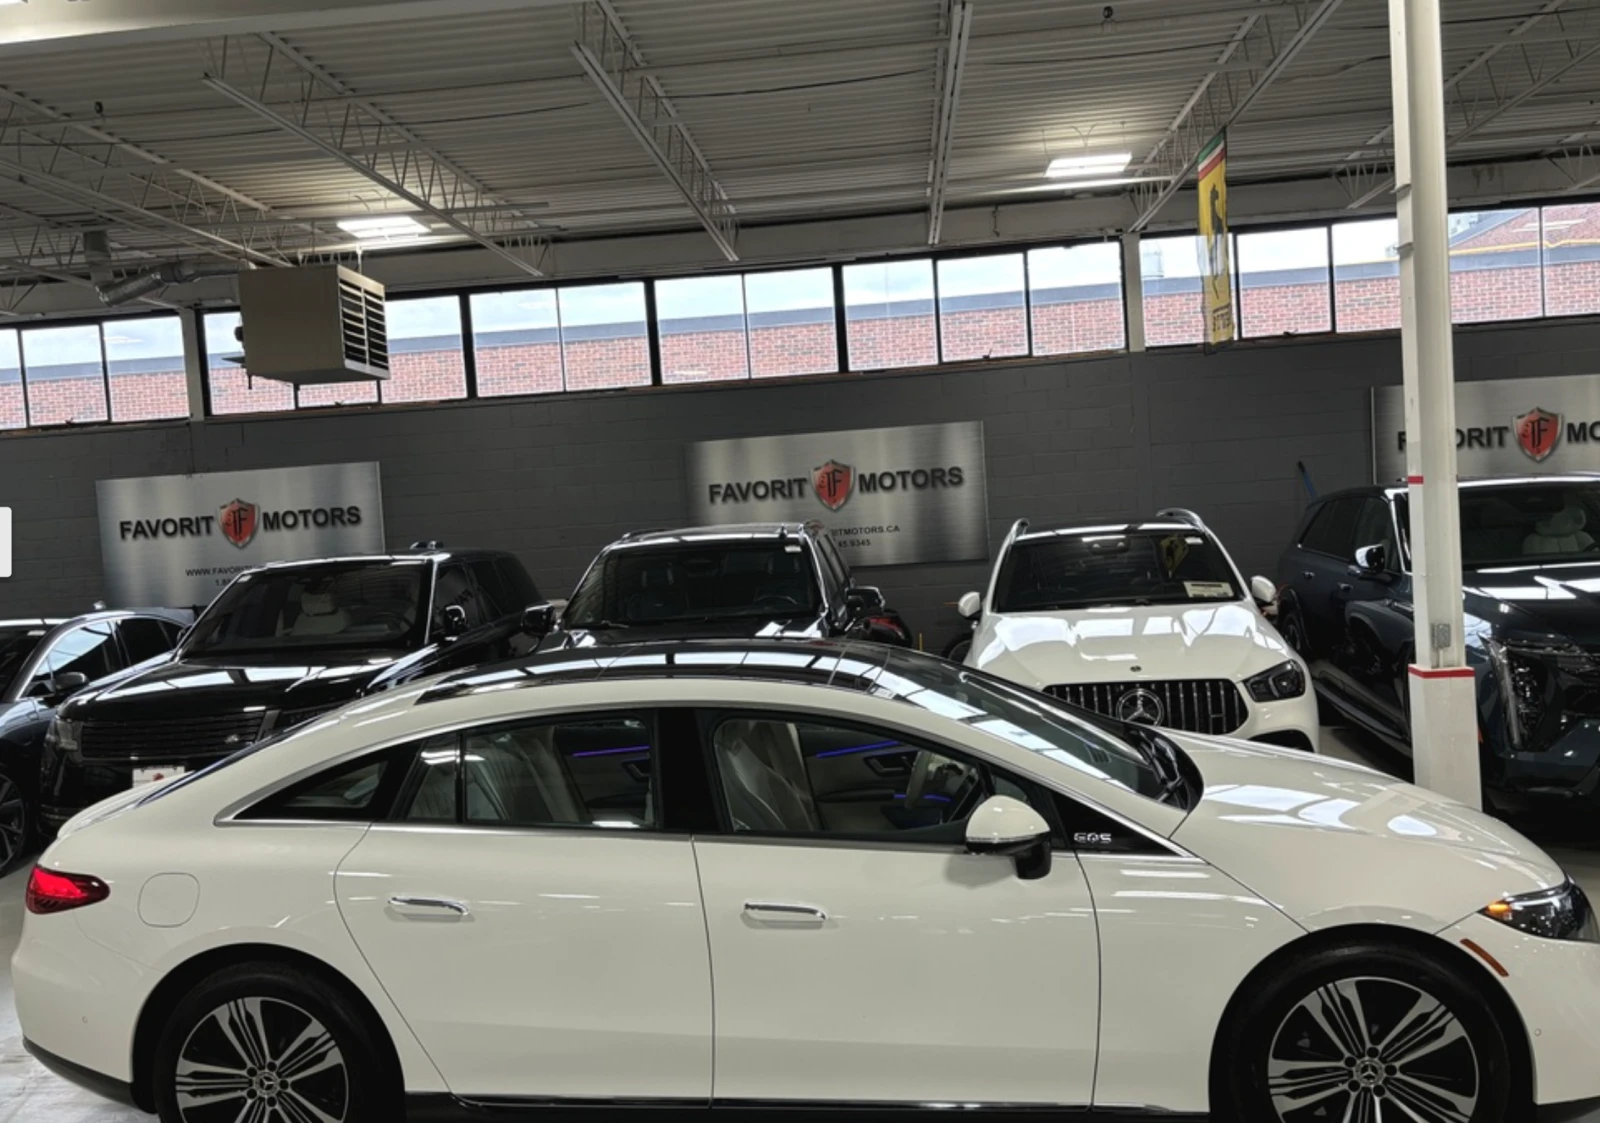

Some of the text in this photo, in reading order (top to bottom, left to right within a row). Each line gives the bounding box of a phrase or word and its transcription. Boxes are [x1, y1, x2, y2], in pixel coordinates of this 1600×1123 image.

[708, 466, 964, 504] FAVORIT MOTORS
[119, 505, 361, 540] FAVORIT MOTORS
[1073, 832, 1112, 844] EQS
